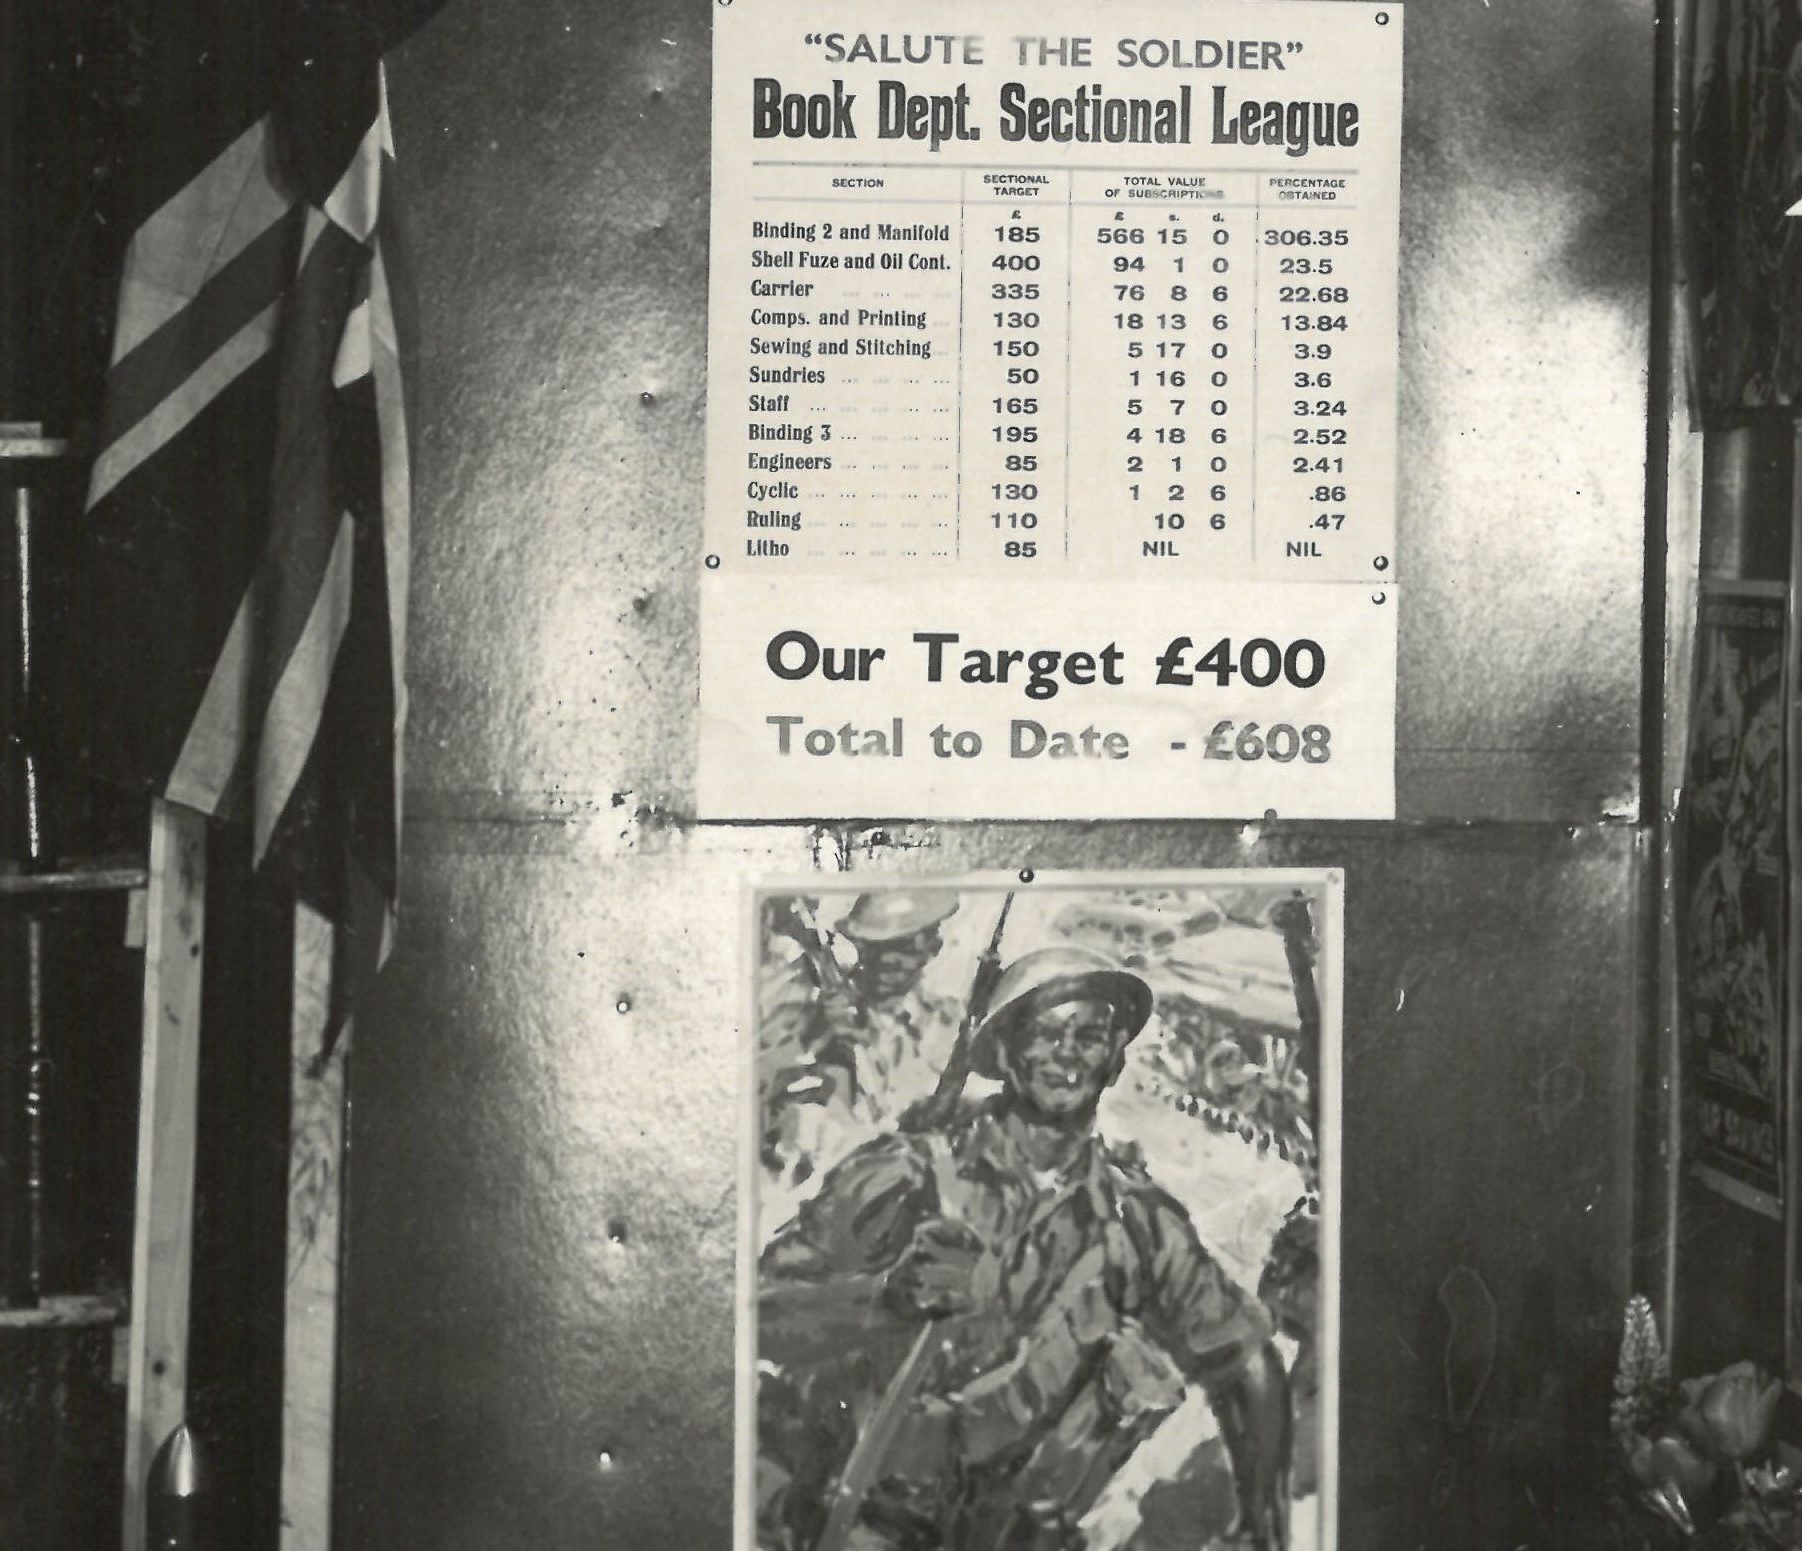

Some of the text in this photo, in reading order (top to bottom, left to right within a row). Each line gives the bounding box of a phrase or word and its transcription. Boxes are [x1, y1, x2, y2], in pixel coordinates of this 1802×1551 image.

[1011, 36, 1092, 67] THE
[752, 77, 1359, 158] Book Dept. Sectional League
[832, 179, 883, 187] SECTION
[984, 175, 1049, 184] SECTIONAL
[1124, 177, 1205, 186] TOTAL VALUE
[1270, 179, 1345, 188] PERCENTAGE
[994, 187, 1039, 196] TARGET
[1105, 189, 1120, 197] OF
[753, 222, 1348, 246] Binding 2 and Manifold 185 566 15 0 306.35
[752, 250, 1333, 274] Shell Fuze and Oil Cont. 400 94 1 0 23.5
[751, 279, 1349, 303] Carrier 335 76 8 6 22.68
[751, 309, 1348, 331] Comps. and Printing 130 18 13 6 13.84
[751, 338, 1331, 360] Sewing and Stitching 150 5 17 0 3.9
[750, 366, 1331, 388] Sundries 50 1 16 0 3.6
[749, 395, 1347, 416] Staff 165 5 7 0 3.24
[749, 424, 1347, 445] Binding 3 195 4 18 6 2.52
[749, 453, 1342, 473] Engineers 85 2 1 0 2.41
[748, 482, 798, 501] Cyclic
[992, 484, 1038, 500] 130
[1129, 485, 1139, 500] 1
[1169, 485, 1184, 500] 2
[1211, 485, 1226, 501] 6
[747, 511, 801, 531] Ruling
[991, 513, 1037, 529] 110
[1155, 513, 1184, 529] 10
[1210, 514, 1225, 530] 6
[747, 539, 1321, 557] Litho 85 NIL NIL
[765, 629, 1326, 701] Our Target £400
[765, 715, 1332, 764] Total to Date £608
